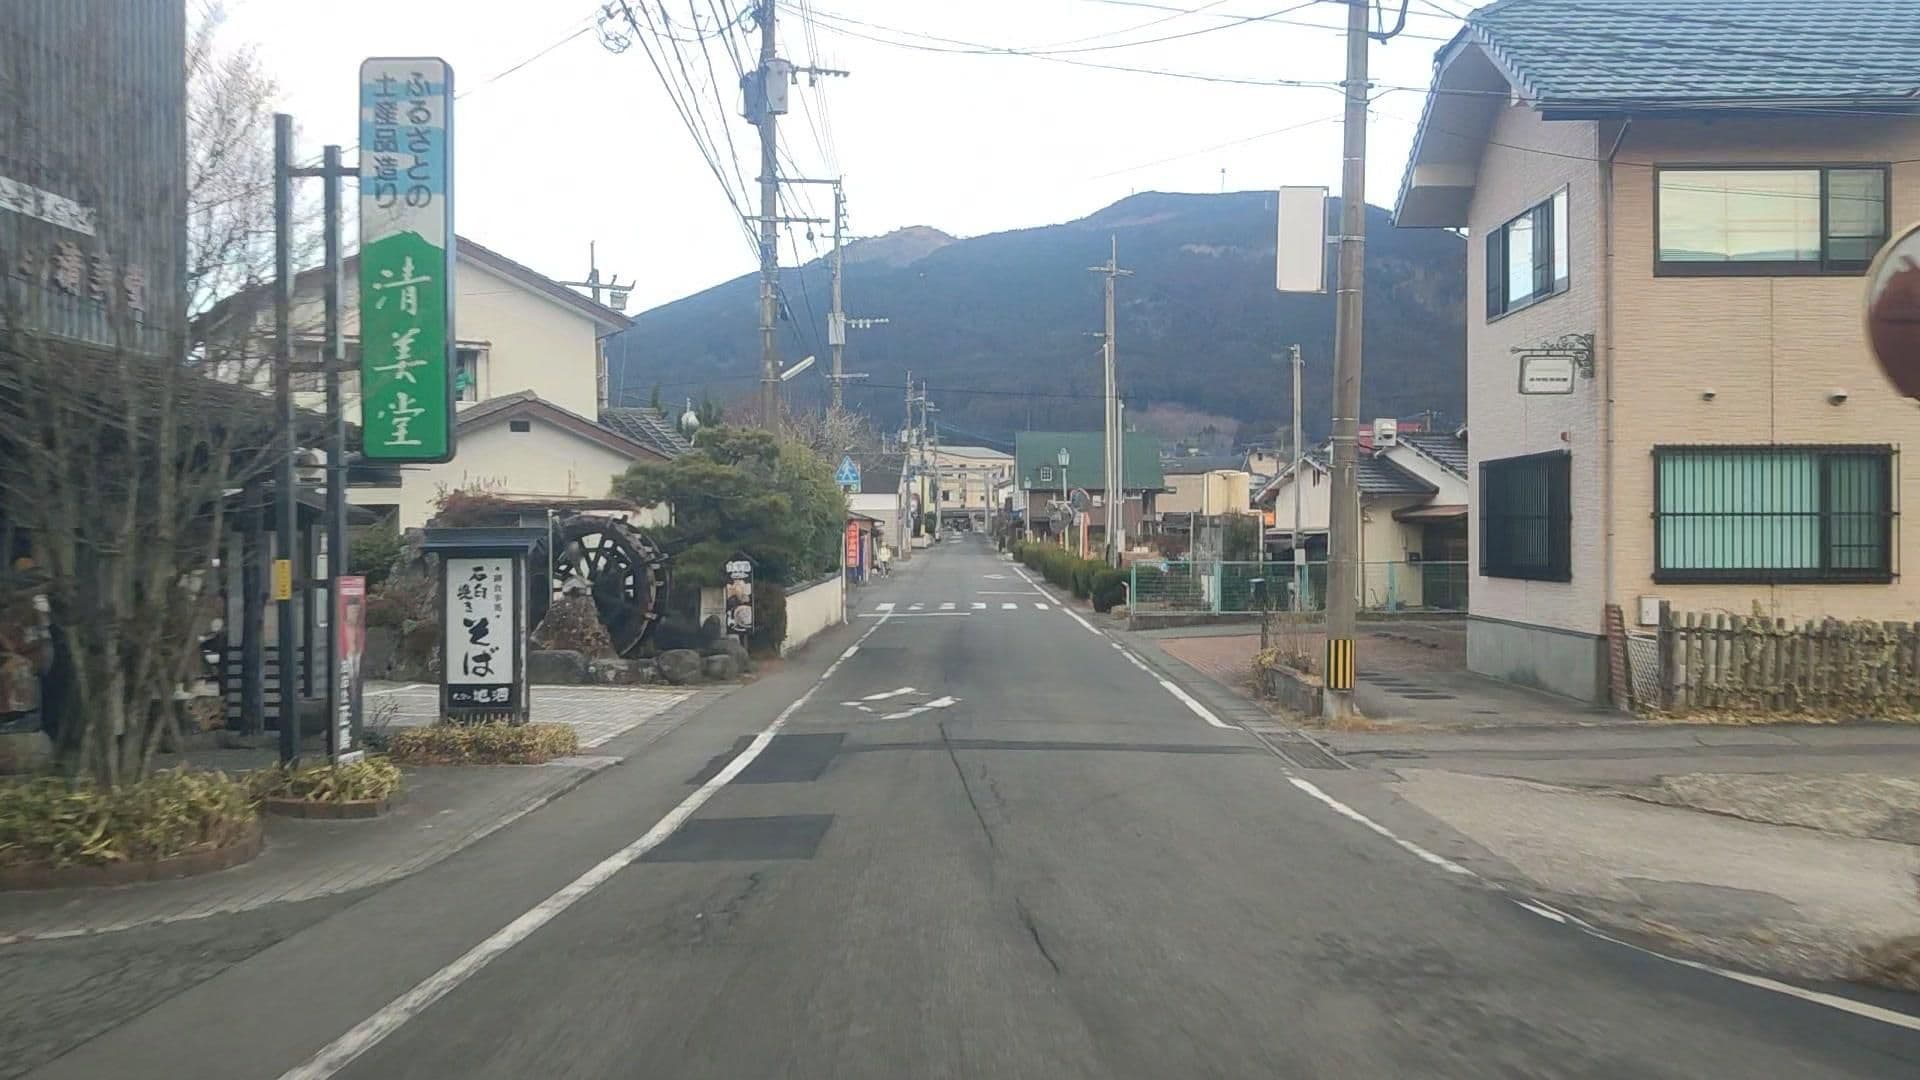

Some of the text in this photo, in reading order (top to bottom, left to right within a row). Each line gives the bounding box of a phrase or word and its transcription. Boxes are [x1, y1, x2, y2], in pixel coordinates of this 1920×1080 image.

[406, 72, 432, 208] ふるさとの
[372, 256, 432, 445] 清美堂
[463, 617, 500, 677] そば
[473, 687, 510, 703] 地酒
